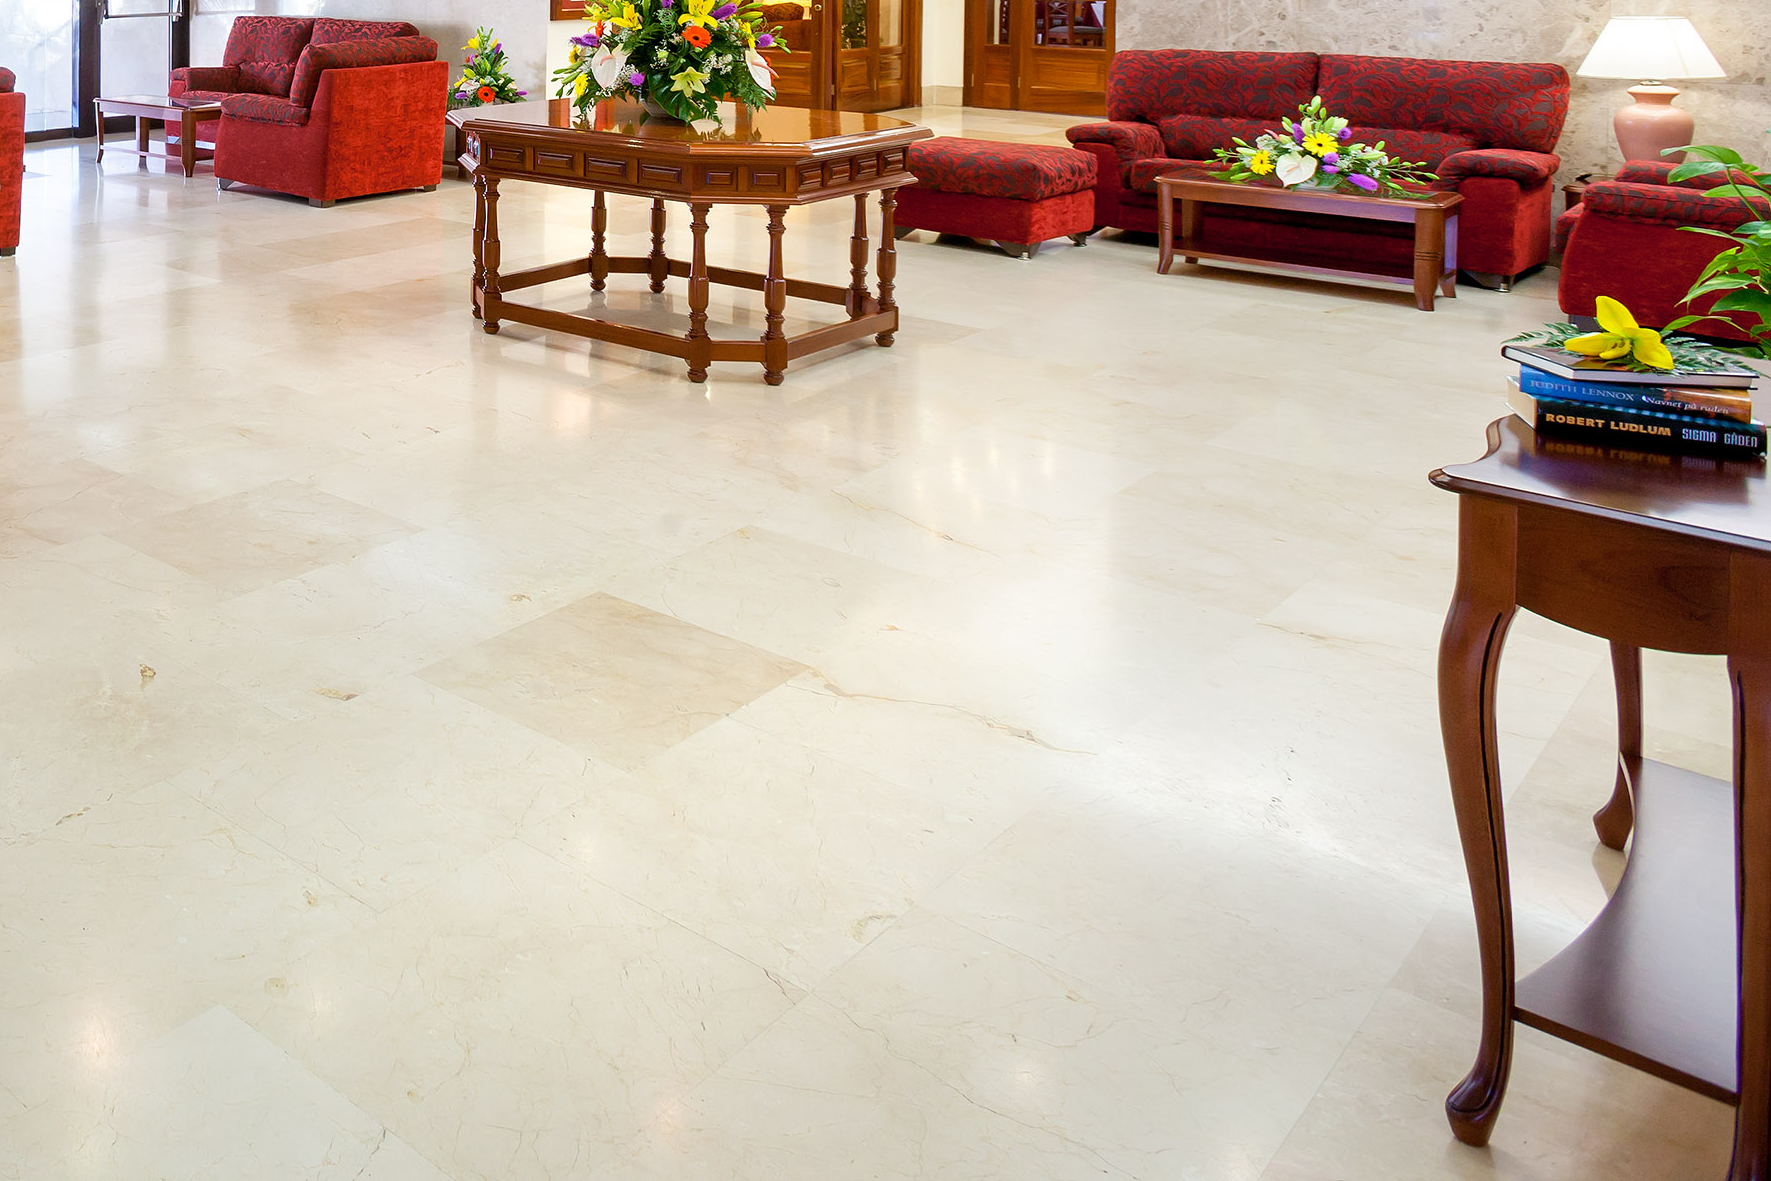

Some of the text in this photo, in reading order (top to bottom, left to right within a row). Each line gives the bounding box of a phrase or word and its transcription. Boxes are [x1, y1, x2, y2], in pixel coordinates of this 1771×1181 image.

[1529, 380, 1635, 401] JUDITH LENNOX
[1642, 395, 1729, 414] Navnet på ruden
[1545, 413, 1671, 436] ROBERT LUDLUM
[1682, 428, 1717, 443] SIGMA
